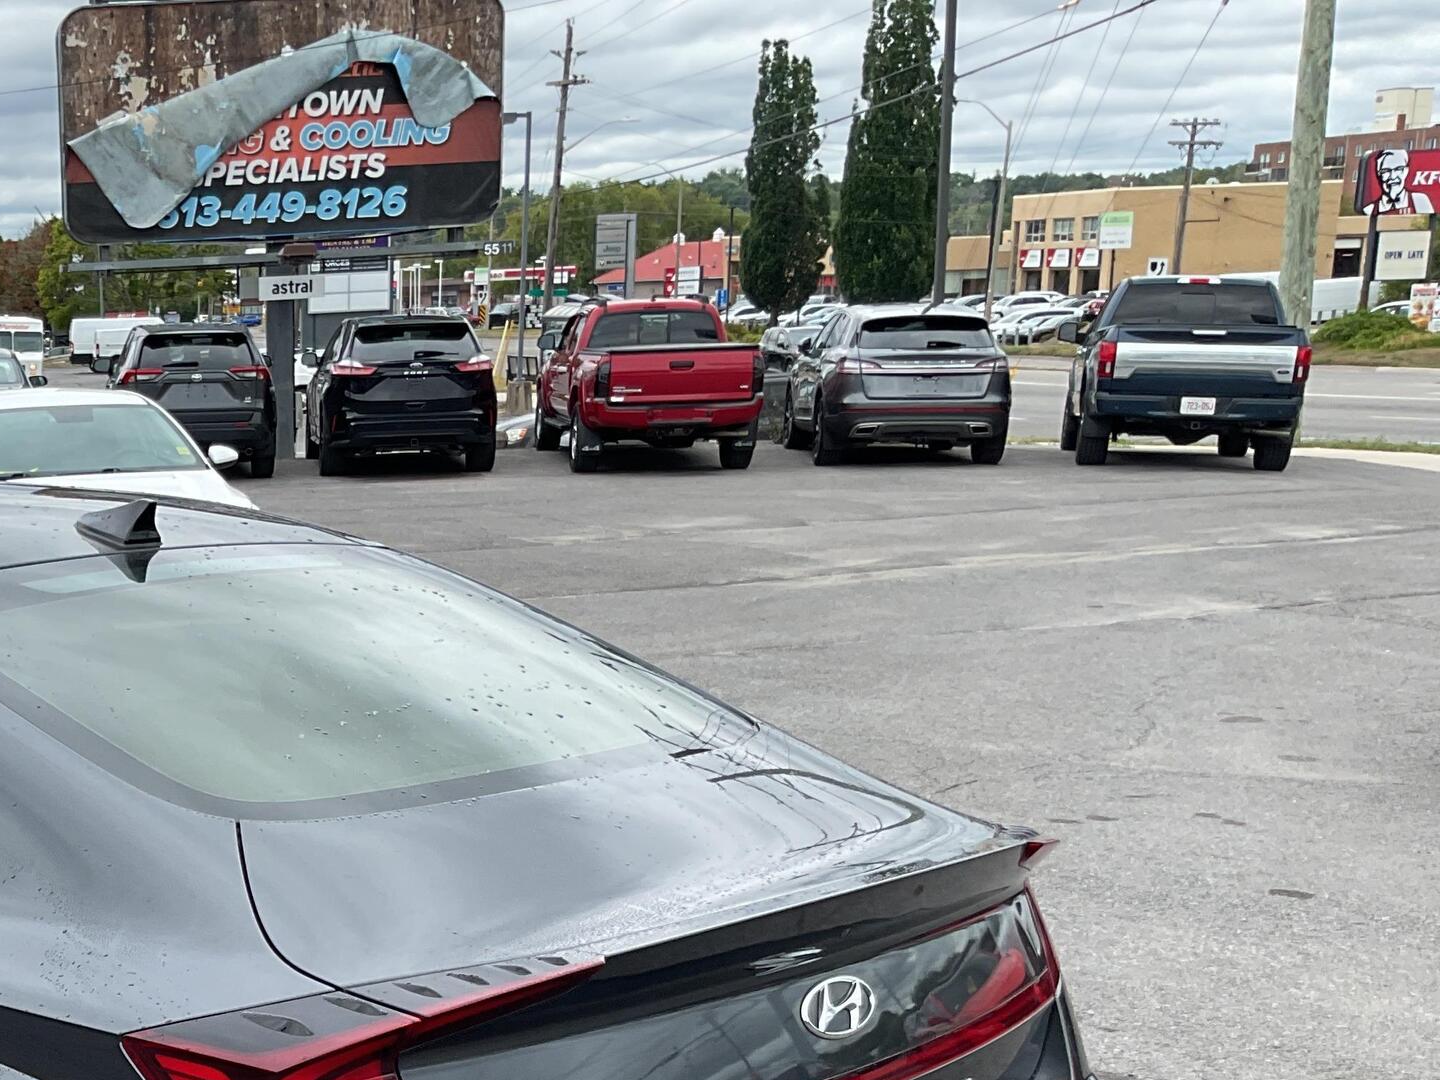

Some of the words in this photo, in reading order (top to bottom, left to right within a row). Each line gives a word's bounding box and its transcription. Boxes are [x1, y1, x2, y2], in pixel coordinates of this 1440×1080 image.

[270, 126, 293, 151] &
[300, 118, 451, 150] COOLING
[194, 152, 386, 187] PECIALISTS
[1412, 170, 1440, 186] KF
[1384, 251, 1403, 259] OPEN
[1407, 250, 1425, 259] LATE
[272, 280, 313, 295] astral
